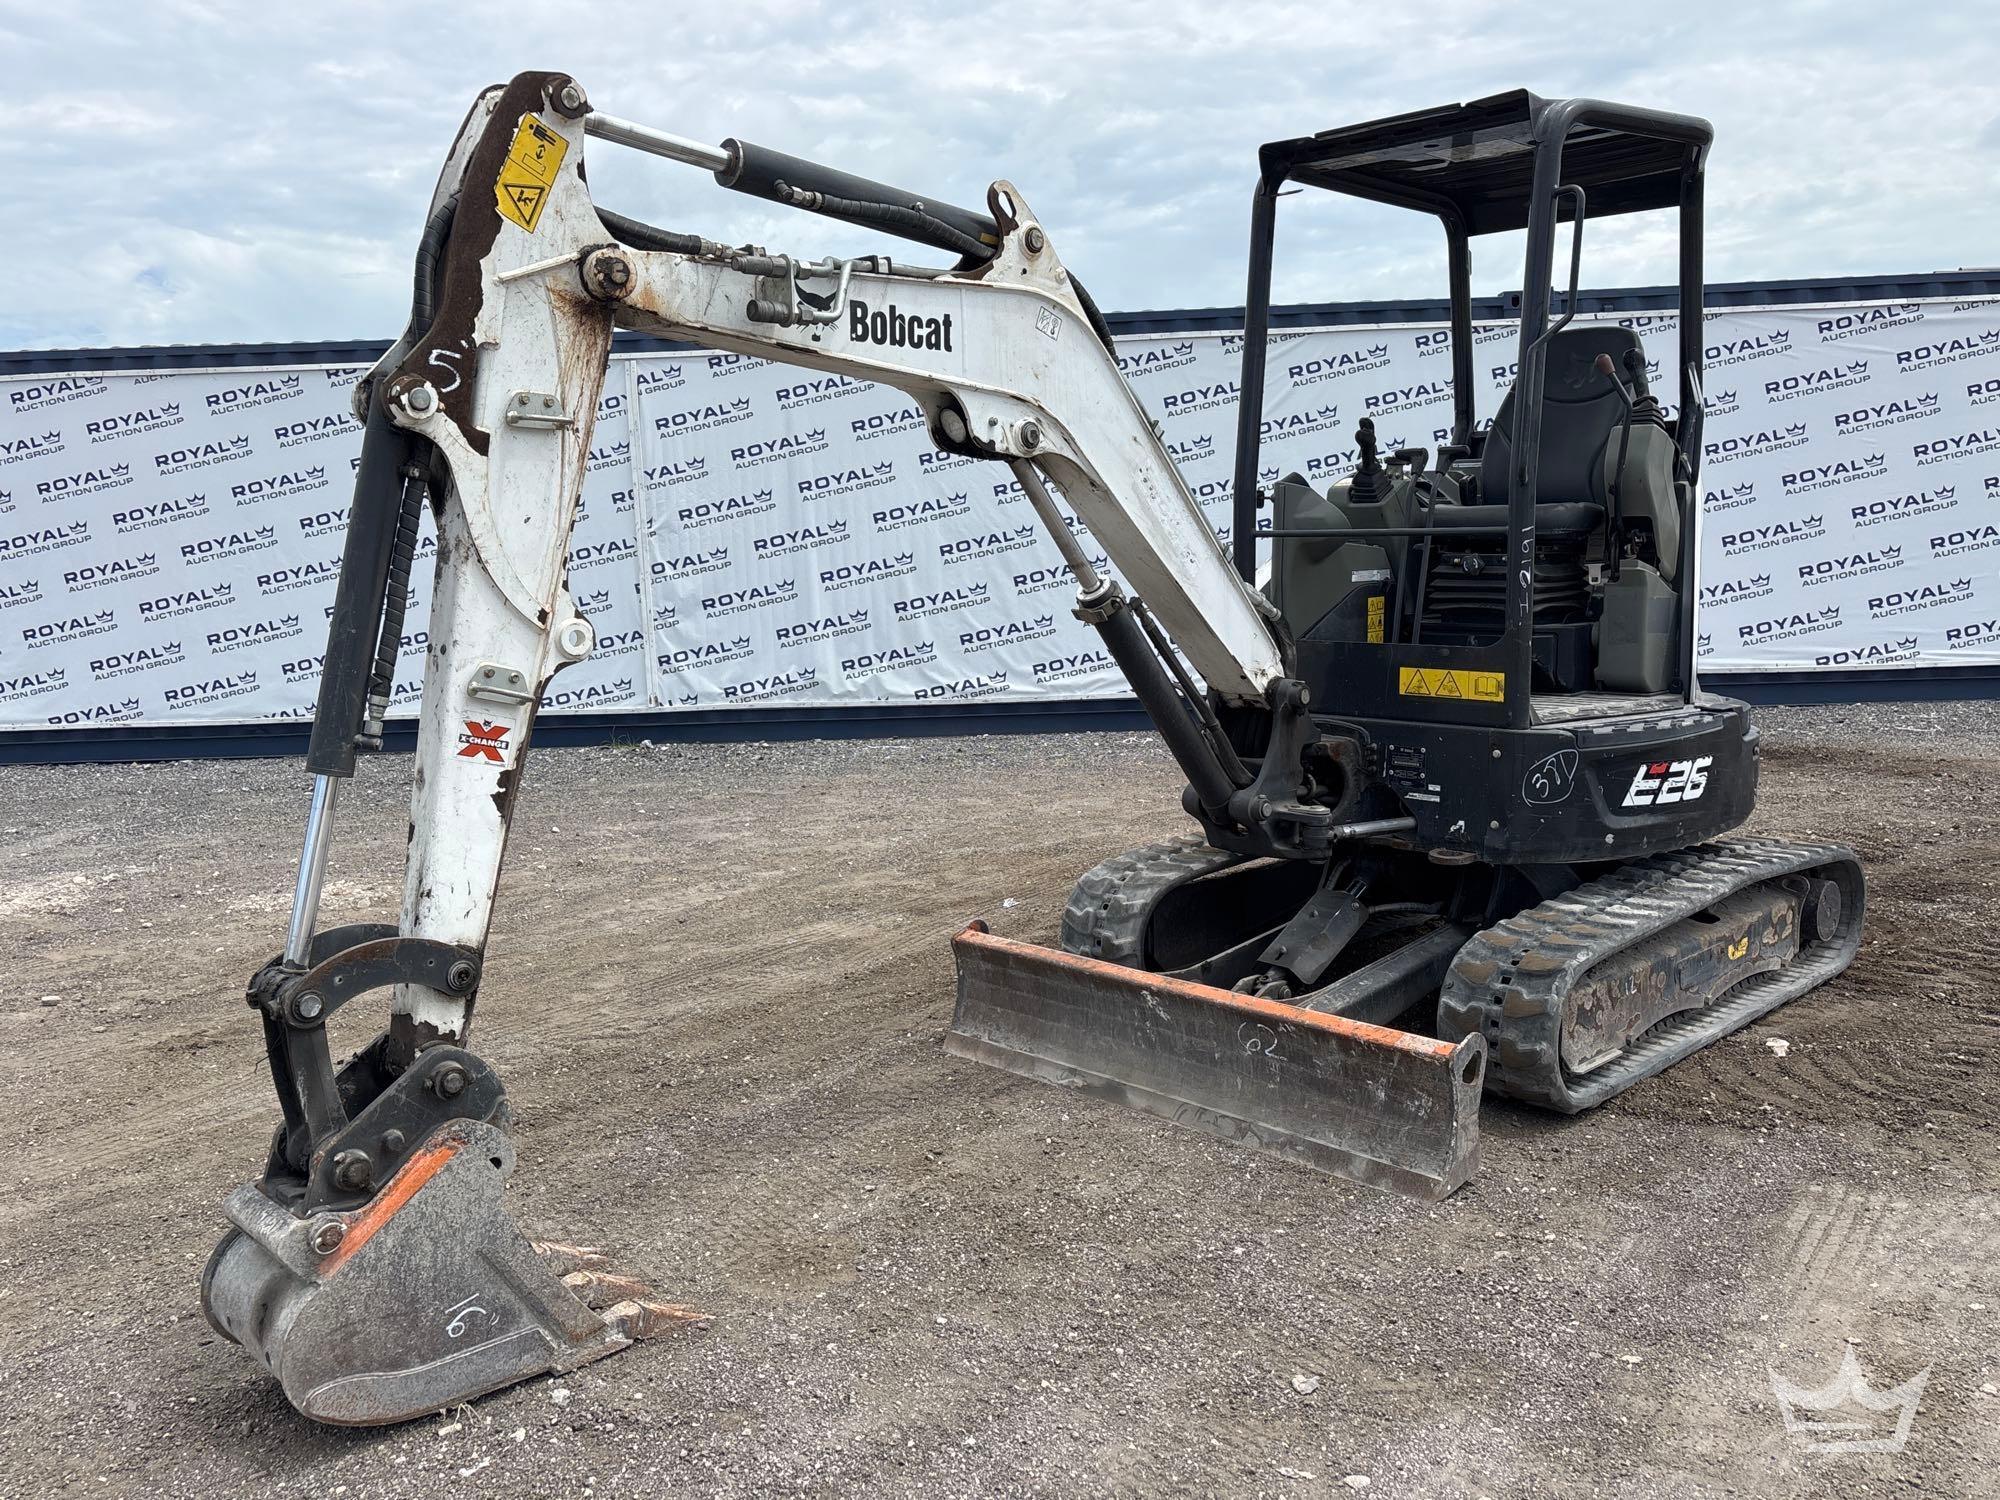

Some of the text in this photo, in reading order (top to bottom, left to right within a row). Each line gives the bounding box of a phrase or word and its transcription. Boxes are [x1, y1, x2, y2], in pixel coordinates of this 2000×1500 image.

[847, 299, 952, 353] Bobcat
[1818, 308, 1900, 334] ROYAL
[1821, 314, 1924, 343] AUCTION GROUP
[1475, 329, 1518, 344] GROUP
[1748, 344, 1792, 360] GROUP
[1897, 337, 1979, 364] ROYAL
[1154, 356, 1197, 372] GROUP
[1288, 351, 1368, 378] ROYAL
[1292, 359, 1390, 388] AUCTION GROUP
[1900, 355, 1956, 374] AUCTION
[10, 379, 85, 405] ROYAL
[776, 374, 852, 402] ROYAL
[1765, 368, 1847, 394] ROYAL
[1768, 375, 1870, 404] AUCTION GROUP
[16, 386, 107, 413] AUCTION GROUP
[206, 382, 281, 407] ROYAL
[211, 389, 304, 416] AUCTION GROUP
[780, 384, 874, 410] AUCTION GROUP
[1163, 381, 1240, 409] ROYAL
[1365, 381, 1444, 409] ROYAL
[655, 404, 731, 430] ROYAL
[1167, 401, 1220, 418] AUCTION
[1368, 399, 1421, 418] AUCTION
[1835, 400, 1917, 427] ROYAL
[86, 409, 162, 435] ROYAL
[92, 417, 184, 444] AUCTION GROUP
[274, 414, 350, 440] ROYAL
[660, 412, 753, 439] AUCTION GROUP
[1298, 420, 1341, 435] GROUP
[1838, 408, 1941, 436] AUCTION GROUP
[280, 432, 330, 448] AUCTION
[731, 435, 806, 461] ROYAL
[1704, 430, 1785, 456] ROYAL
[1708, 438, 1809, 465] AUCTION GROUP
[1914, 430, 1996, 457] ROYAL
[154, 442, 230, 467] ROYAL
[160, 450, 253, 476] AUCTION GROUP
[736, 443, 828, 470] AUCTION GROUP
[1917, 448, 1973, 466] AUCTION
[36, 470, 112, 495] ROYAL
[231, 472, 306, 498] ROYAL
[798, 468, 874, 493] ROYAL
[1782, 460, 1864, 487] ROYAL
[1785, 468, 1887, 496] AUCTION GROUP
[42, 477, 134, 504] AUCTION GROUP
[236, 480, 328, 506] AUCTION GROUP
[802, 476, 896, 502] AUCTION GROUP
[112, 500, 187, 525] ROYAL
[678, 496, 754, 521] ROYAL
[683, 503, 776, 530] AUCTION GROUP
[873, 499, 948, 524] ROYAL
[1852, 492, 1934, 519] ROYAL
[1855, 500, 1958, 528] AUCTION GROUP
[118, 508, 210, 534] AUCTION GROUP
[877, 506, 970, 533] AUCTION GROUP
[181, 532, 256, 557] ROYAL
[754, 526, 828, 552] ROYAL
[758, 534, 850, 560] AUCTION GROUP
[939, 532, 1015, 556] ROYAL
[1722, 522, 1802, 547] ROYAL
[1725, 529, 1826, 556] AUCTION GROUP
[1, 535, 92, 561] AUCTION GROUP
[186, 540, 278, 566] AUCTION GROUP
[944, 539, 1037, 565] AUCTION GROUP
[64, 559, 138, 584] ROYAL
[257, 562, 331, 587] ROYAL
[820, 558, 895, 583] ROYAL
[1799, 552, 1880, 578] ROYAL
[1802, 560, 1904, 587] AUCTION GROUP
[69, 567, 160, 593] AUCTION GROUP
[262, 579, 312, 596] AUCTION
[824, 566, 917, 592] AUCTION GROUP
[139, 590, 214, 614] ROYAL
[144, 597, 236, 623] AUCTION GROUP
[701, 586, 776, 610] ROYAL
[706, 593, 798, 619] AUCTION GROUP
[894, 589, 968, 614] ROYAL
[898, 597, 990, 622] AUCTION GROUP
[1868, 584, 1950, 610] ROYAL
[1872, 592, 1974, 620] AUCTION GROUP
[22, 616, 96, 641] ROYAL
[28, 624, 118, 650] AUCTION GROUP
[206, 621, 281, 646] ROYAL
[776, 616, 850, 640] ROYAL
[780, 623, 871, 648] AUCTION GROUP
[960, 621, 1034, 645] ROYAL
[1739, 613, 1819, 638] ROYAL
[1742, 620, 1842, 647] AUCTION GROUP
[212, 628, 302, 654] AUCTION GROUP
[964, 628, 1056, 654] AUCTION GROUP
[90, 648, 164, 672] ROYAL
[657, 642, 732, 667] ROYAL
[662, 650, 754, 675] AUCTION GROUP
[842, 647, 916, 672] ROYAL
[846, 655, 937, 680] AUCTION GROUP
[1032, 650, 1108, 676] ROYAL
[95, 655, 185, 681] AUCTION GROUP
[1036, 666, 1087, 685] AUCTION
[164, 677, 238, 702] ROYAL
[169, 685, 260, 710] AUCTION GROUP
[460, 735, 507, 749] X-CHANGE
[1621, 755, 1714, 807] E26
